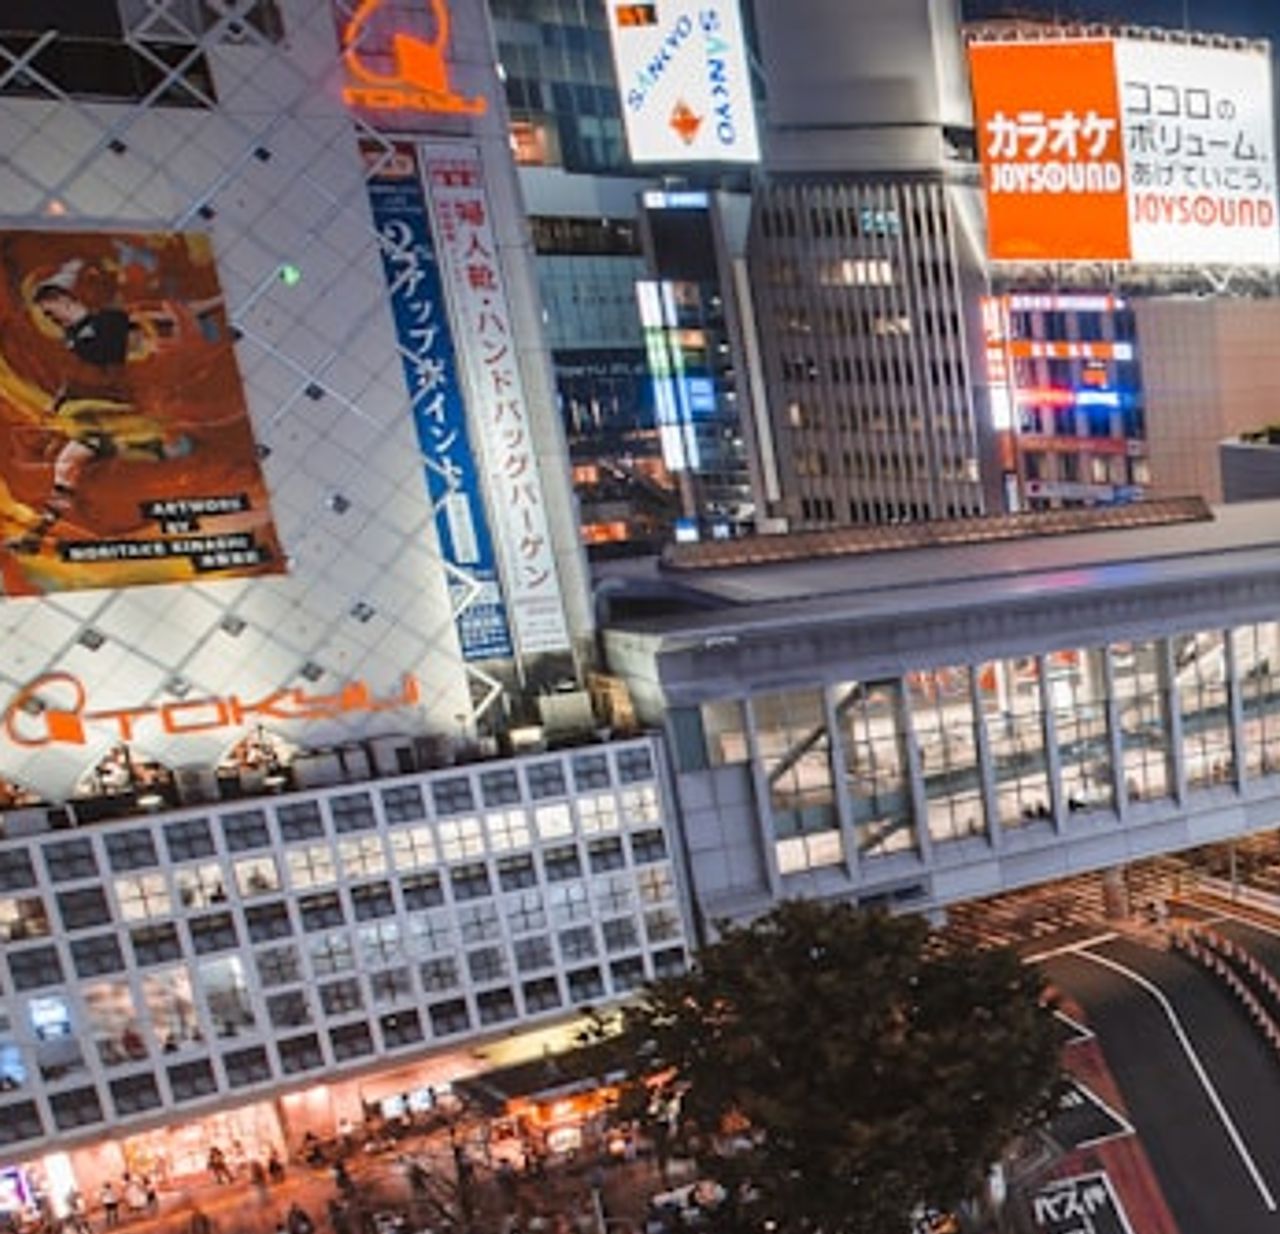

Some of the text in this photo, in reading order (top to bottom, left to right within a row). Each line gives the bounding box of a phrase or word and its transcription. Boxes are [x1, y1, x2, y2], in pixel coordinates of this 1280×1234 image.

[628, 15, 693, 112] SANKYO
[700, 8, 736, 146] SANKYO
[1125, 81, 1239, 122] ココロの
[985, 111, 1119, 160] カラオケ
[989, 162, 1123, 195] JOYSOUND
[1133, 193, 1274, 228] JOYSOUND
[101, 676, 420, 743] TOKYU
